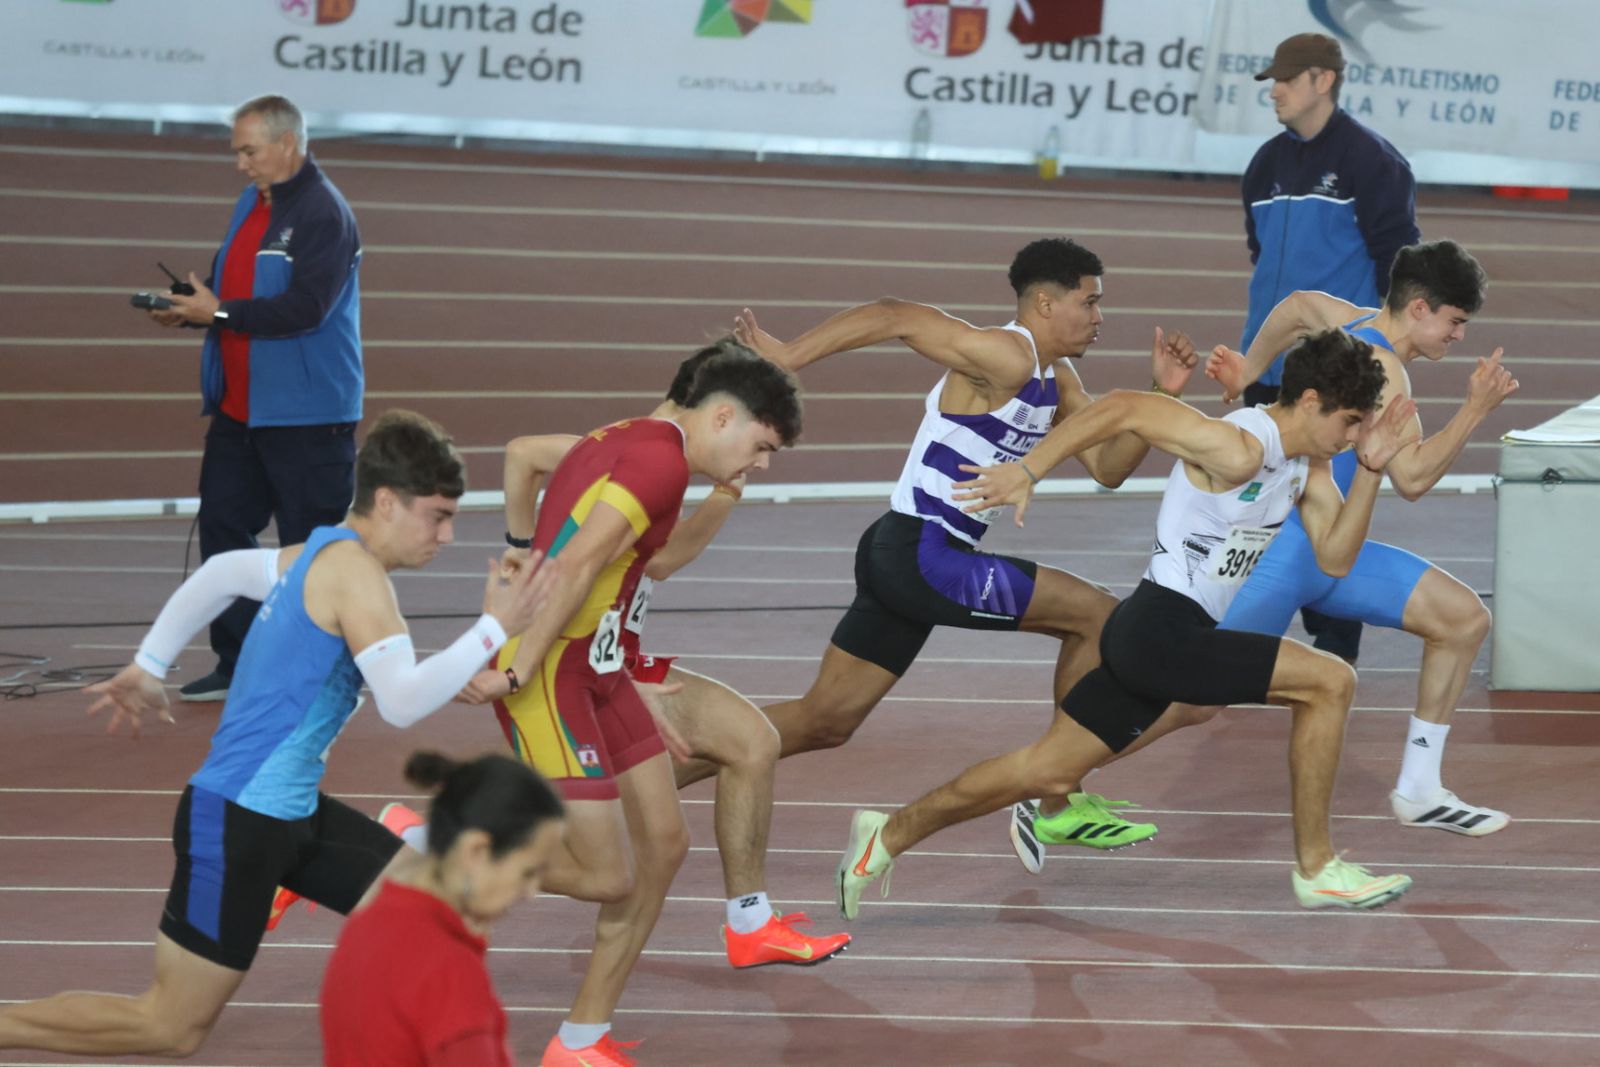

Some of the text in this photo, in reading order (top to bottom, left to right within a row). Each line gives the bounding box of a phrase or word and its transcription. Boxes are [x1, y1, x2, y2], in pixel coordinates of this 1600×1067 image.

[395, 0, 583, 36] Junta de
[273, 35, 583, 87] Castilla y León
[1158, 37, 1204, 72] de
[904, 67, 1055, 108] Castilla
[1065, 84, 1092, 119] y
[1348, 64, 1375, 85] DE
[1380, 66, 1500, 95] ATLETISMO
[1397, 98, 1411, 118] Y
[1430, 101, 1496, 125] LEÓN
[1549, 110, 1581, 132] DE
